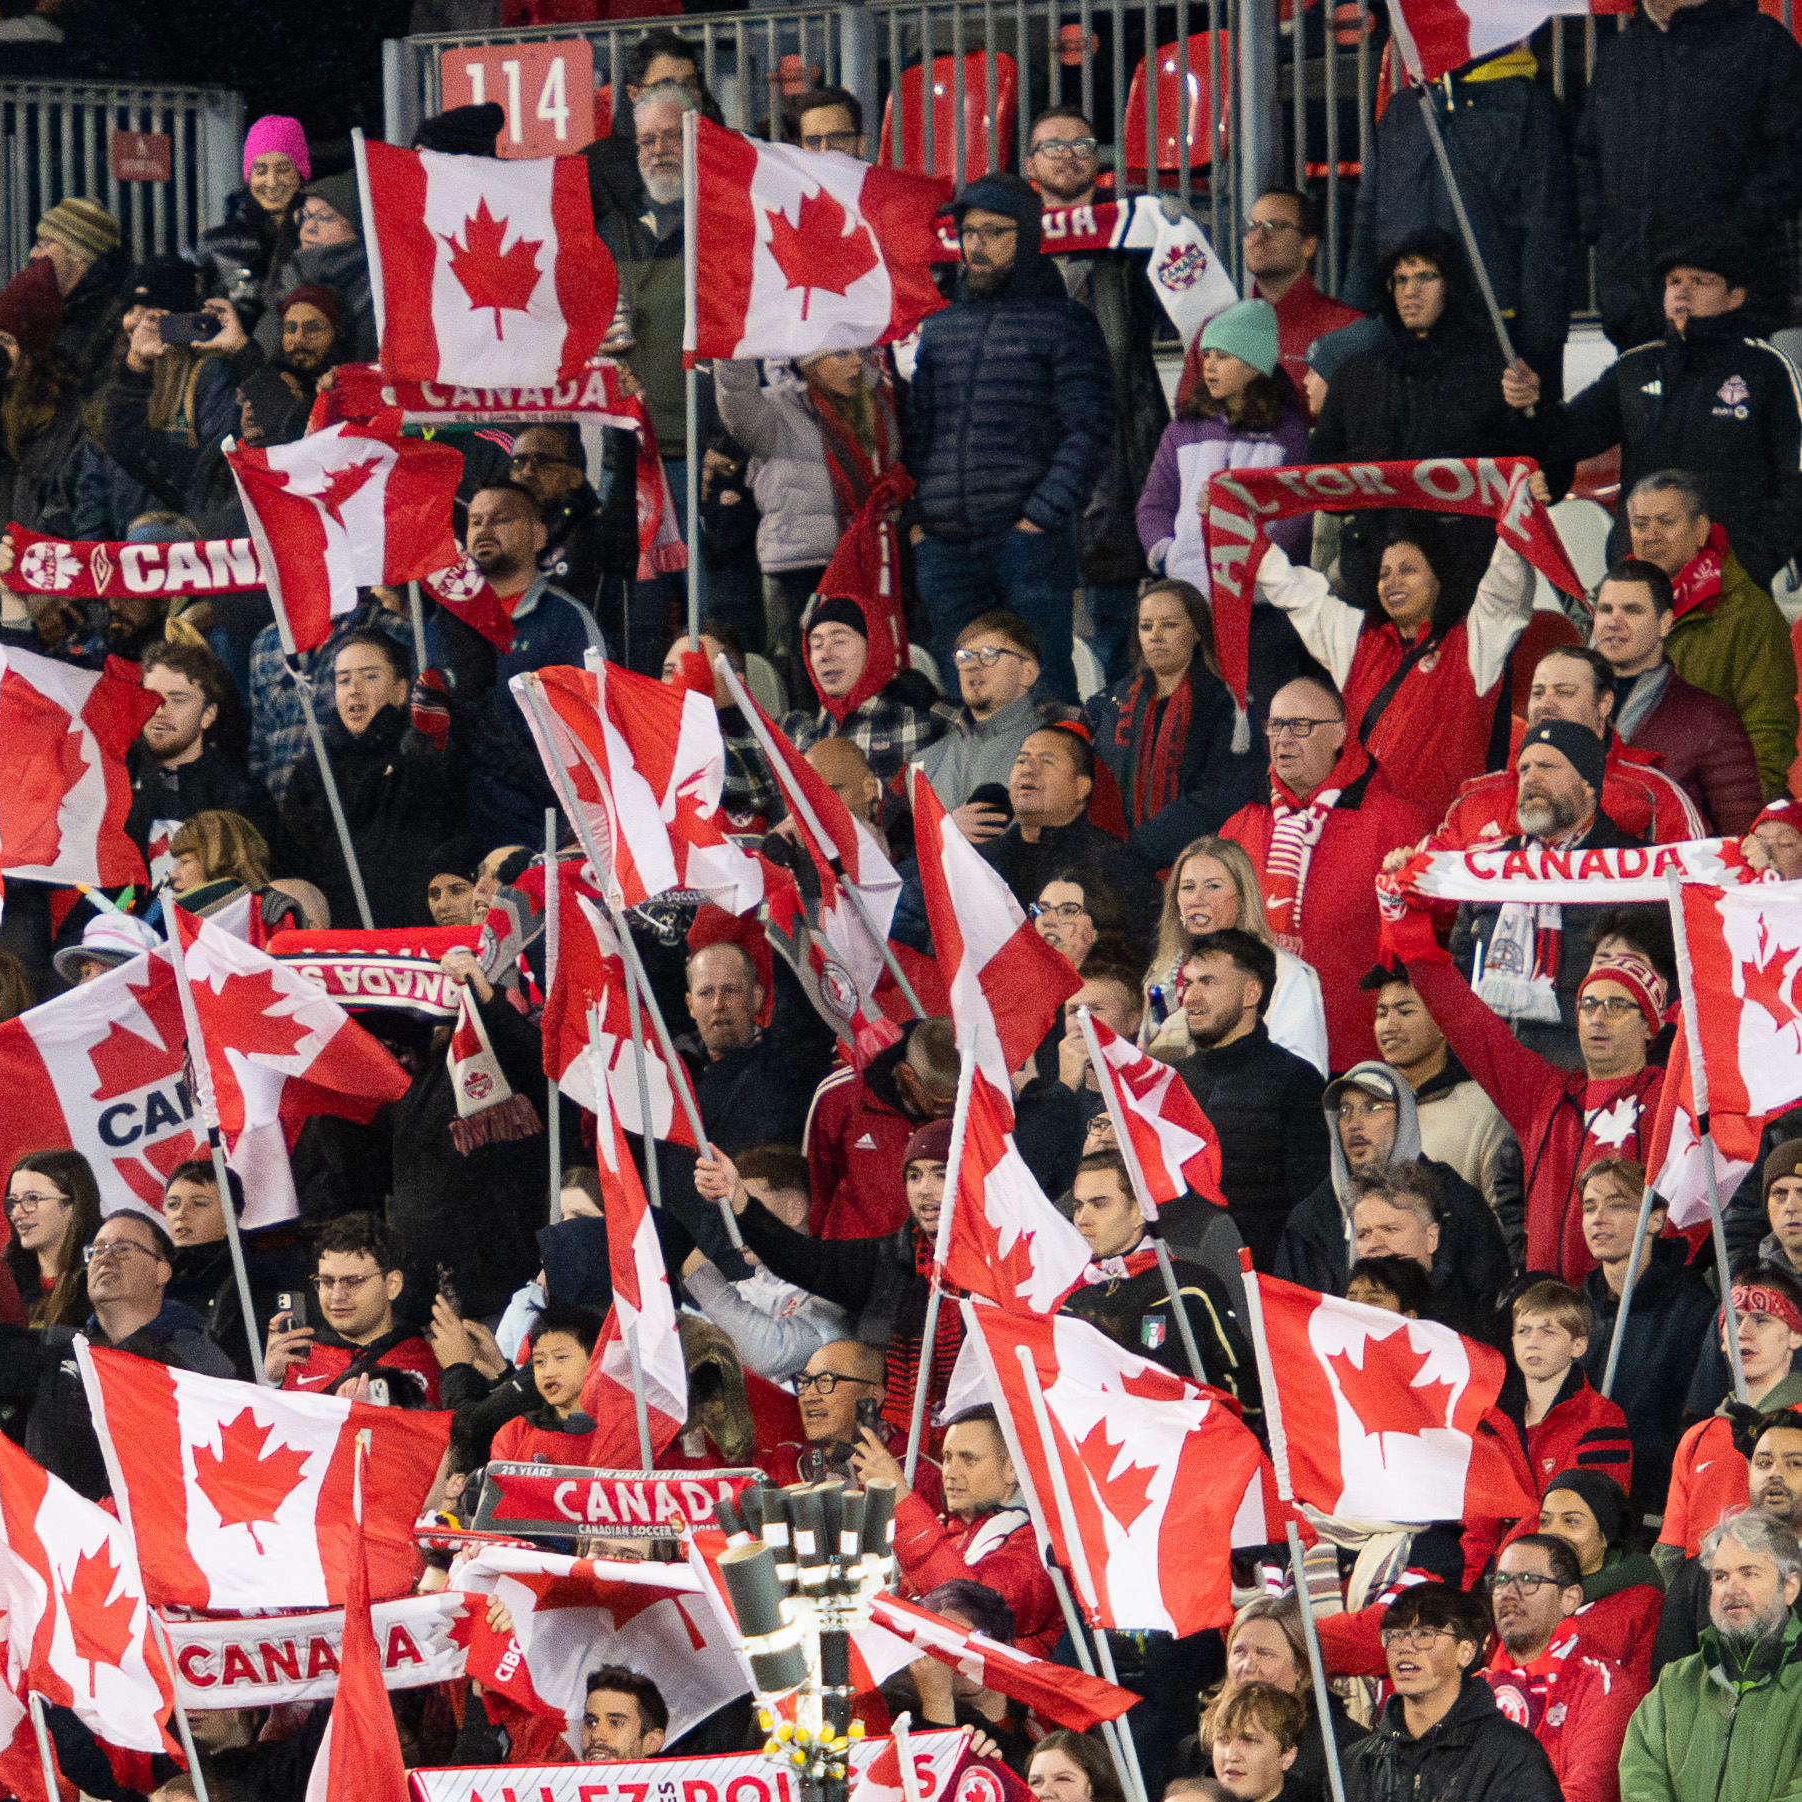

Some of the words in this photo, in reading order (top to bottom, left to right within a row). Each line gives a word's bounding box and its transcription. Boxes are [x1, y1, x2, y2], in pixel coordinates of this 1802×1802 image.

[463, 56, 565, 144] 114
[1277, 464, 1389, 500] FOR
[118, 537, 271, 591] CAN
[1463, 845, 1687, 881] CANADA
[332, 964, 461, 1003] ANADA
[94, 1080, 199, 1149] CAN
[519, 1464, 554, 1477] YEARS
[553, 1478, 730, 1522] CANADA
[578, 1524, 631, 1537] CANADIAN
[632, 1524, 672, 1537] SOCCER
[179, 1625, 426, 1686] CANAA
